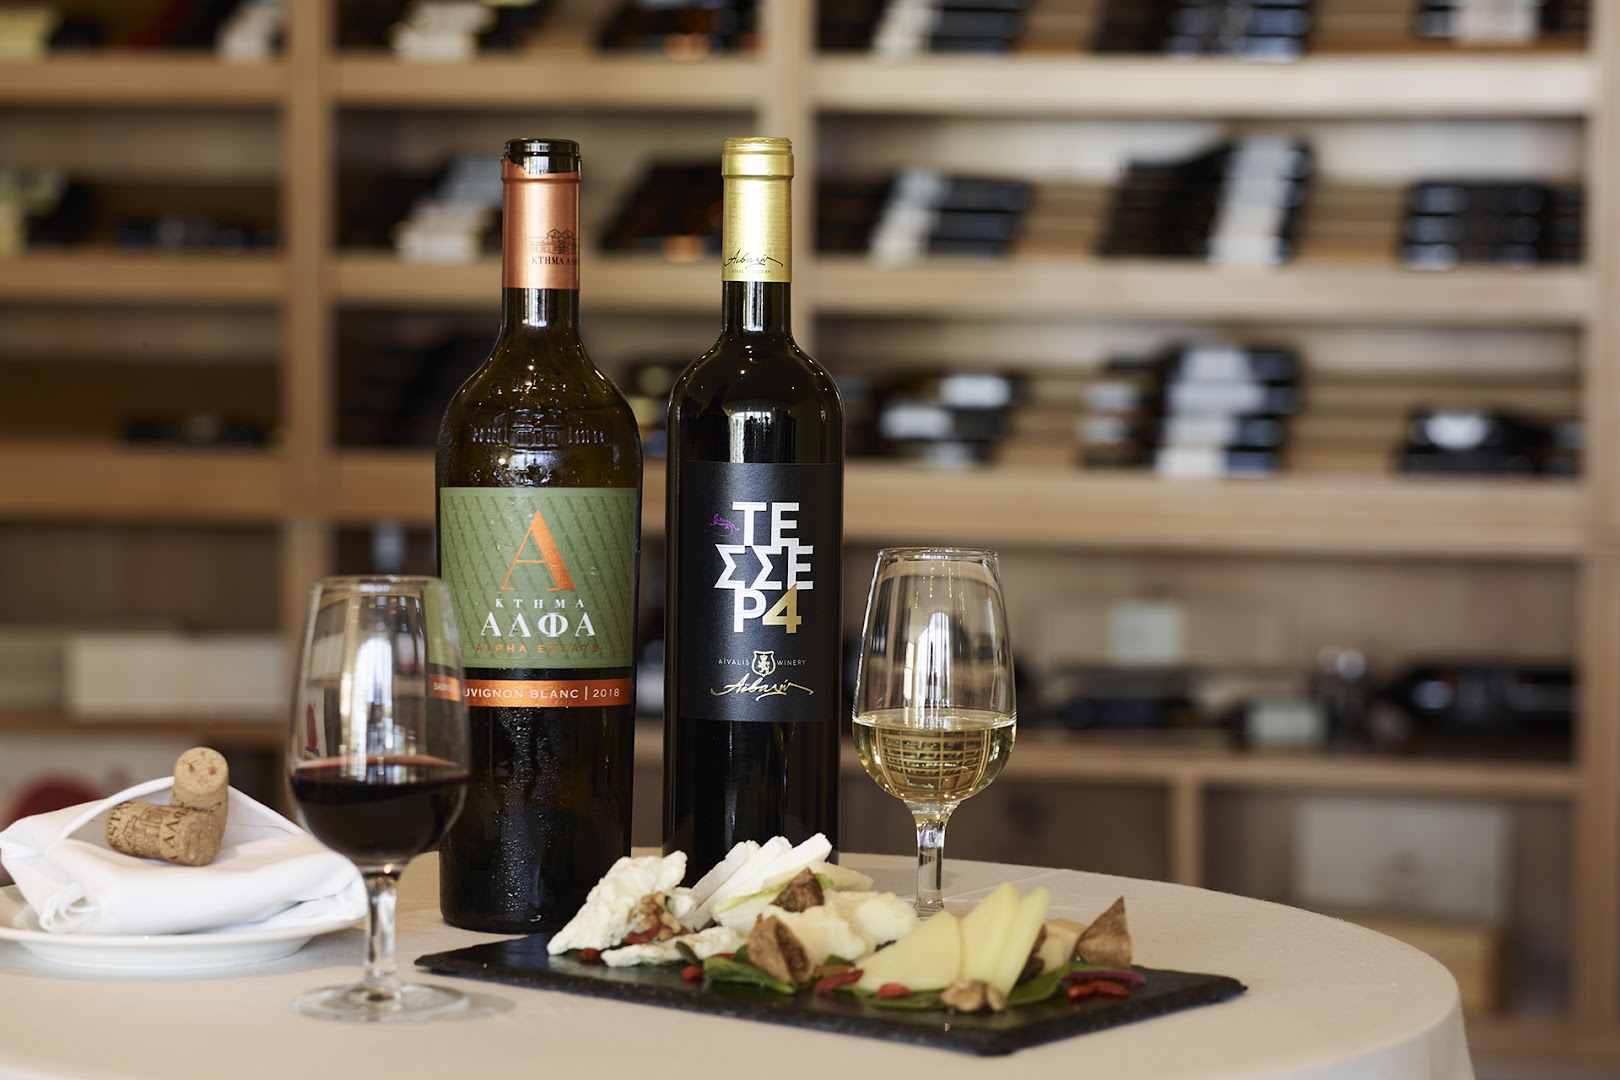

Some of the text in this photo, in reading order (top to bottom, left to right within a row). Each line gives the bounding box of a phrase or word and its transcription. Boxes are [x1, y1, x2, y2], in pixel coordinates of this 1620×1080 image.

[501, 509, 577, 591] Α
[495, 598, 584, 609] ΚΤΗΜΑ
[481, 611, 596, 637] ΑΛΦΑ
[475, 643, 599, 653] ALPHA ESTATE
[530, 689, 579, 699] BLANC
[592, 688, 620, 698] 2018
